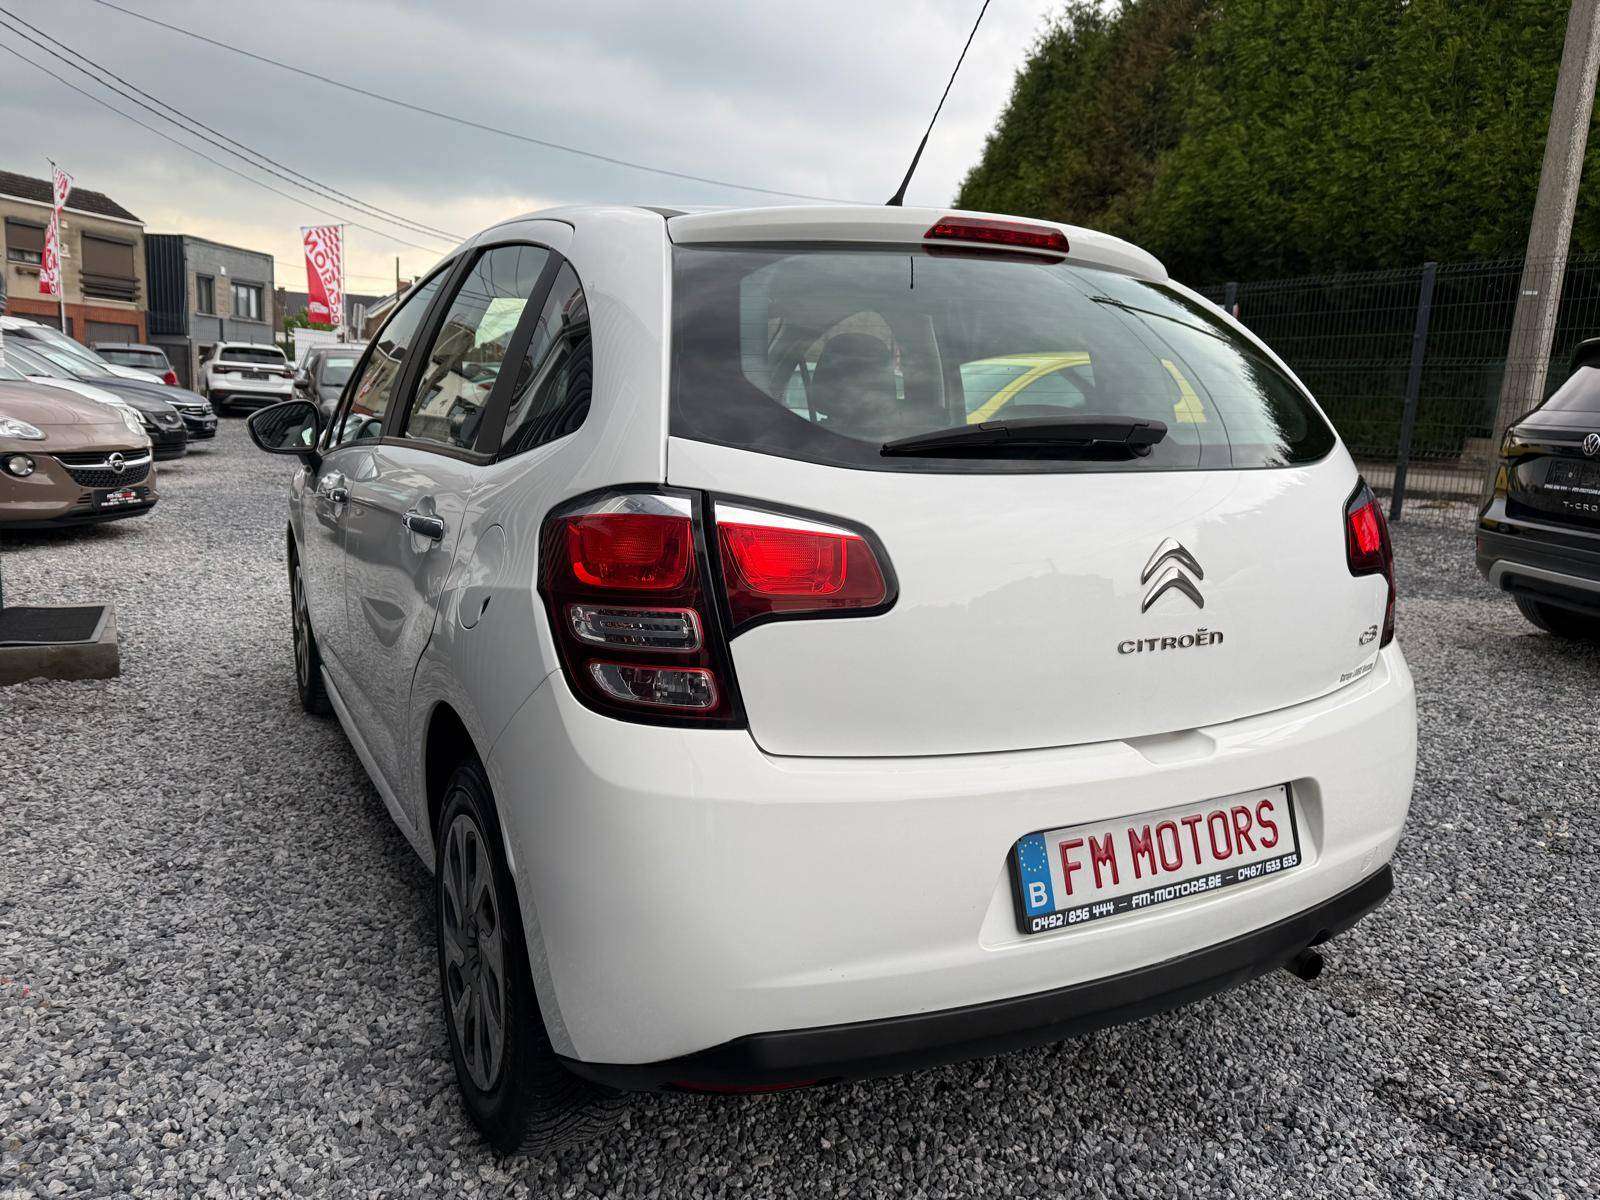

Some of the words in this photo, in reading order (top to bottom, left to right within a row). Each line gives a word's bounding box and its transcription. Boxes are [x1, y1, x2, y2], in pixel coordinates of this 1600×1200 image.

[1359, 624, 1378, 646] C3
[1059, 832, 1119, 896] FM
[1128, 799, 1279, 879] MOTORS
[1029, 881, 1048, 908] B
[1032, 907, 1089, 931] 0492/856
[1092, 901, 1115, 917] 444
[1237, 859, 1281, 881] 0487/633
